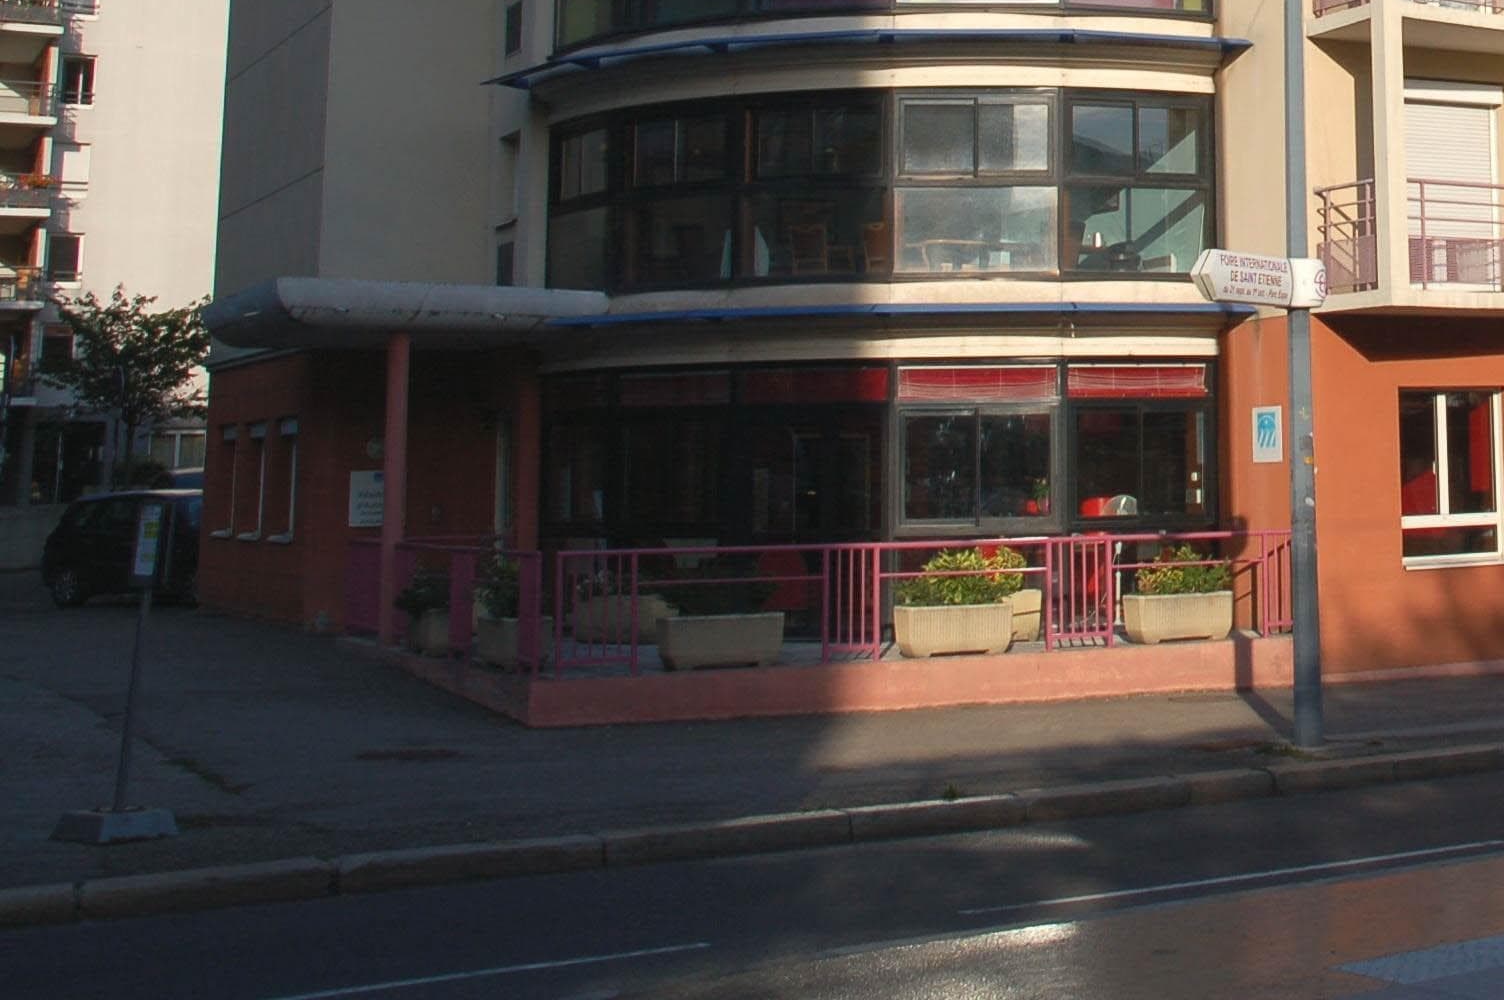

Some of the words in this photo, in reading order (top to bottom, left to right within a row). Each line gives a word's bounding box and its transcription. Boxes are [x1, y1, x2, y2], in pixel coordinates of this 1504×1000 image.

[1220, 254, 1239, 267] FOIRE
[1230, 270, 1239, 282] DE
[1240, 271, 1257, 284] SAINT
[1258, 273, 1282, 287] ETIENNE
